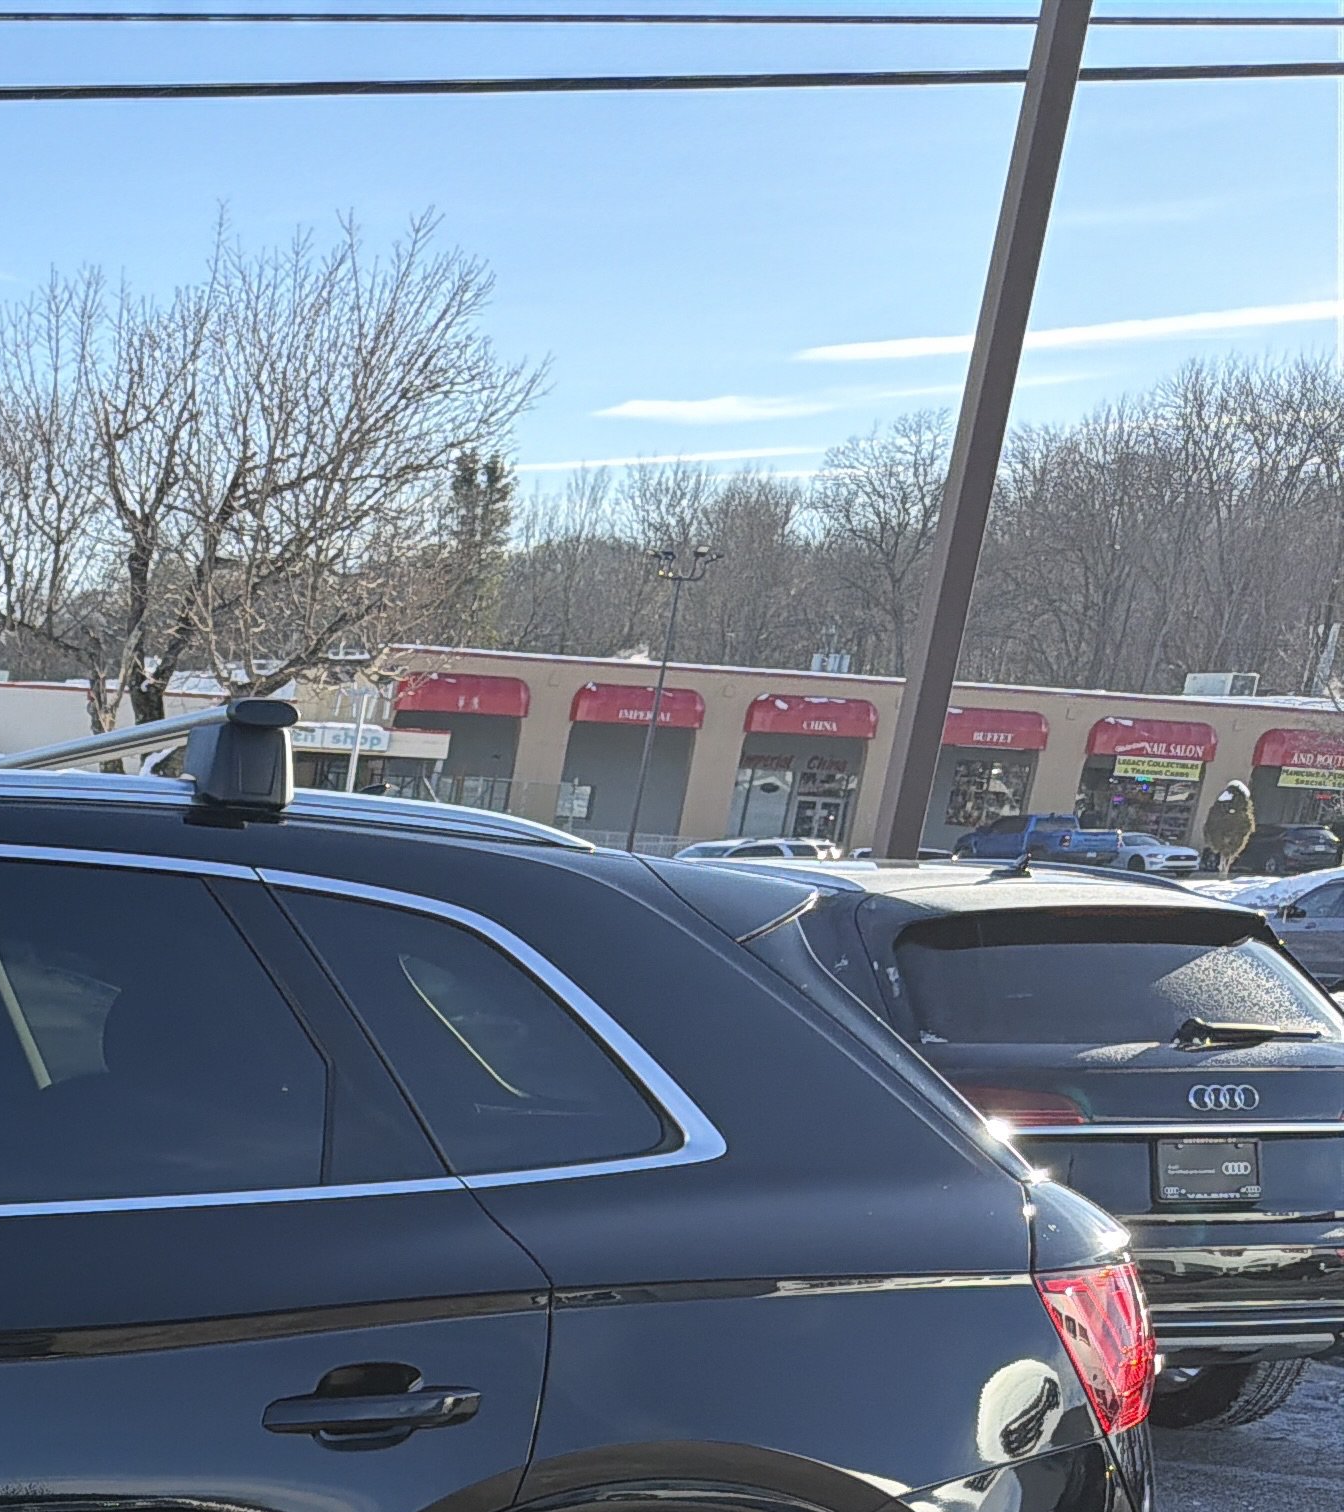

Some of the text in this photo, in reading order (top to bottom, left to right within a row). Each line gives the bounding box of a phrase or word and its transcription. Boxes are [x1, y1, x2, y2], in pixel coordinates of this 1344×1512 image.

[618, 708, 671, 722] IMPERAL
[802, 719, 838, 732] CHINA
[972, 731, 1014, 744] BUFFET
[1143, 742, 1169, 755] NAIL
[1169, 743, 1205, 758] SALON
[1290, 751, 1314, 765] AND
